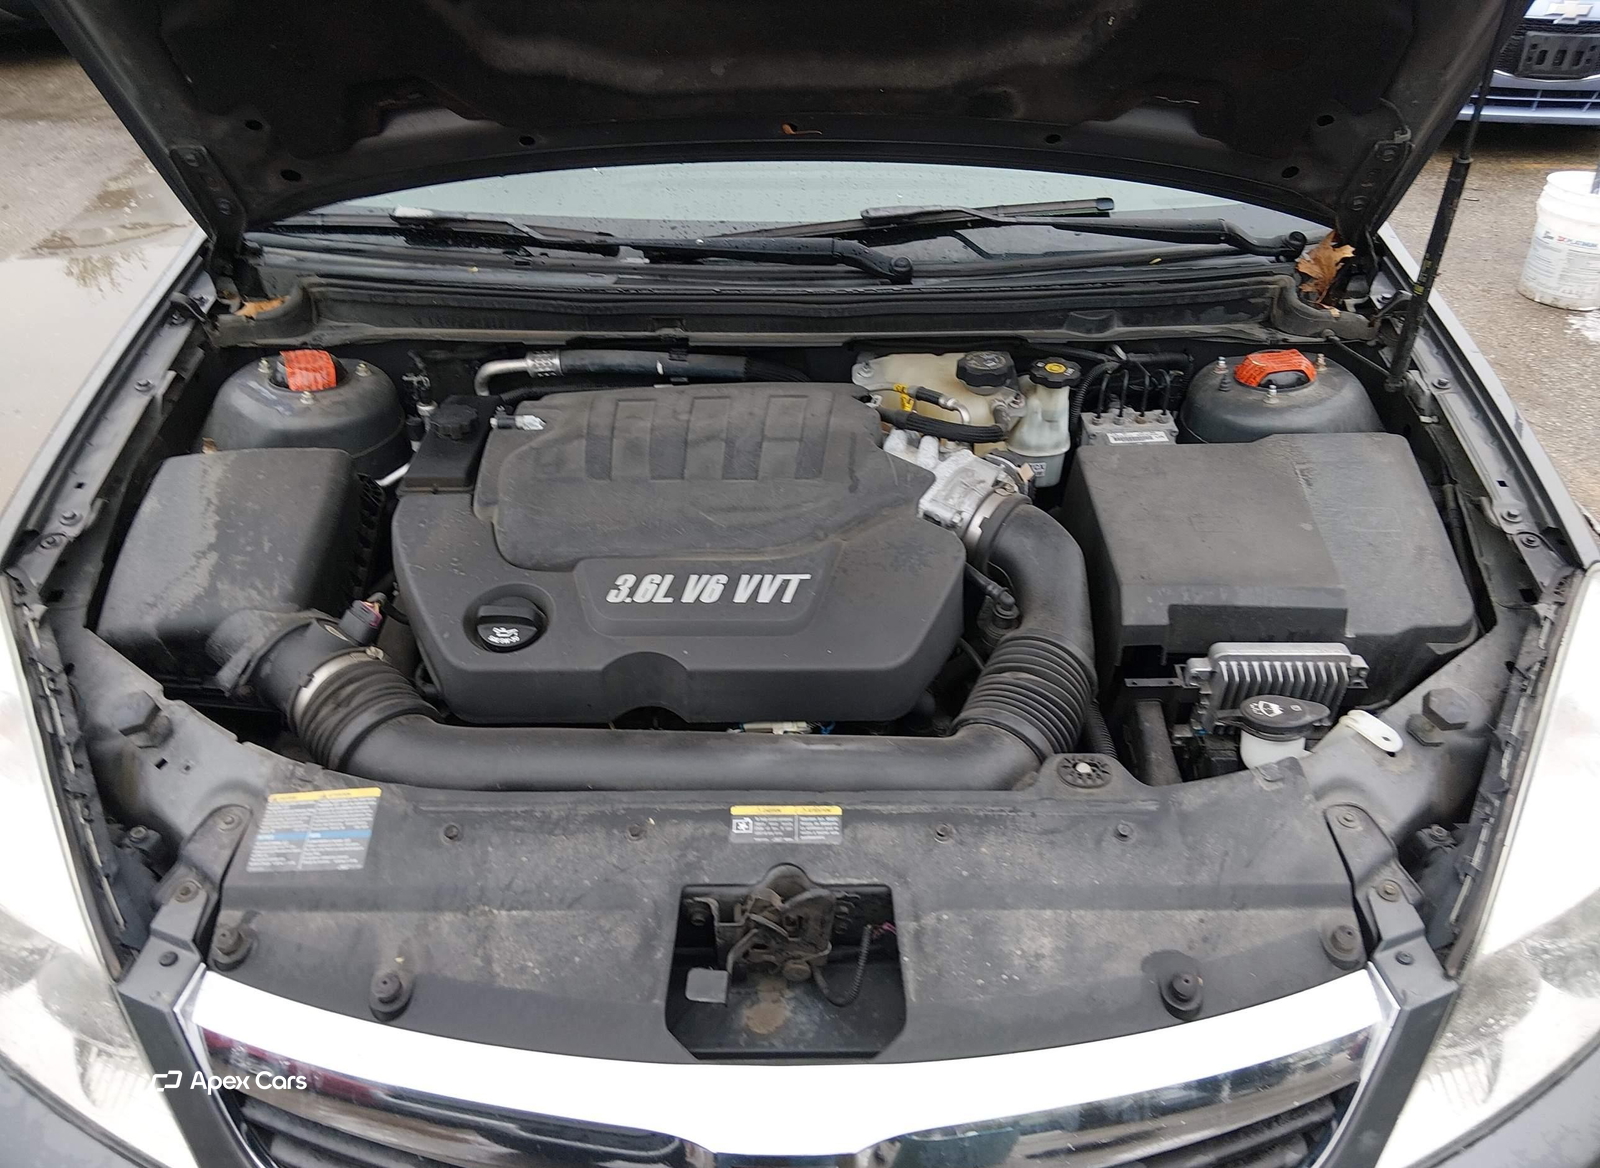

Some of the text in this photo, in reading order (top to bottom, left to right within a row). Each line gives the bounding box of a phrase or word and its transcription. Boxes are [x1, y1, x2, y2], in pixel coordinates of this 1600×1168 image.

[606, 573, 812, 603] 3.6L V6 VVT
